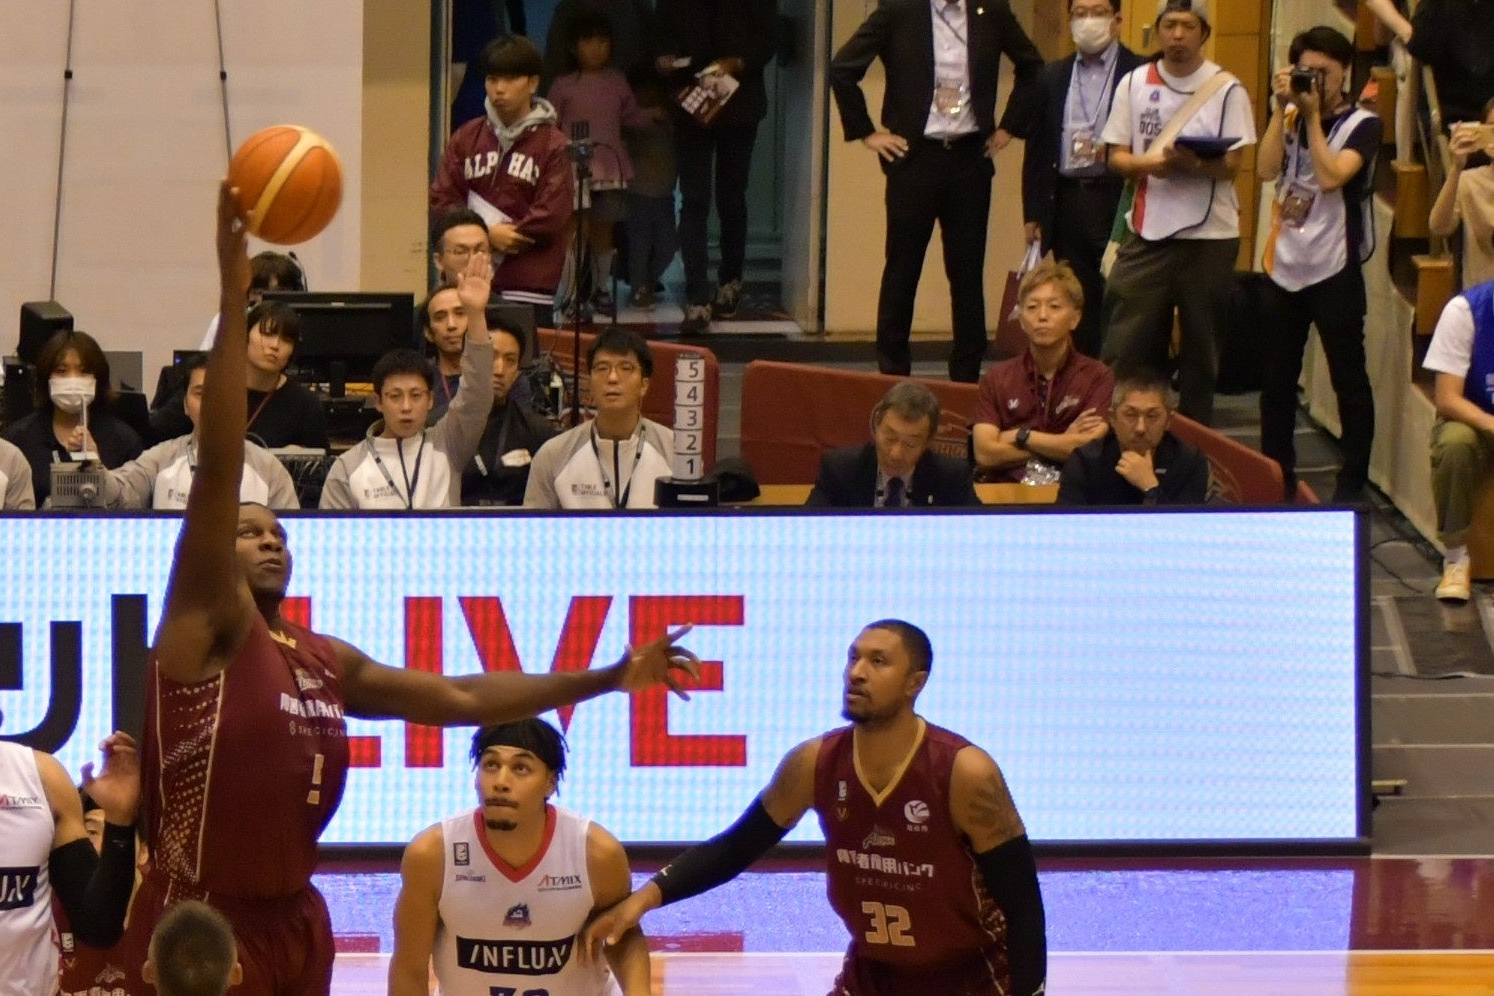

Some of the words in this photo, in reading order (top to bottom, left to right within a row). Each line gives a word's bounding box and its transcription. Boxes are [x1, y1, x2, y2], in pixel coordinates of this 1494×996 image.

[688, 361, 699, 378] 5
[686, 385, 698, 402] 4
[687, 409, 698, 427] 3
[686, 434, 697, 451] 2
[686, 458, 694, 475] 1
[861, 901, 916, 947] 32
[469, 943, 568, 969] INFLUX
